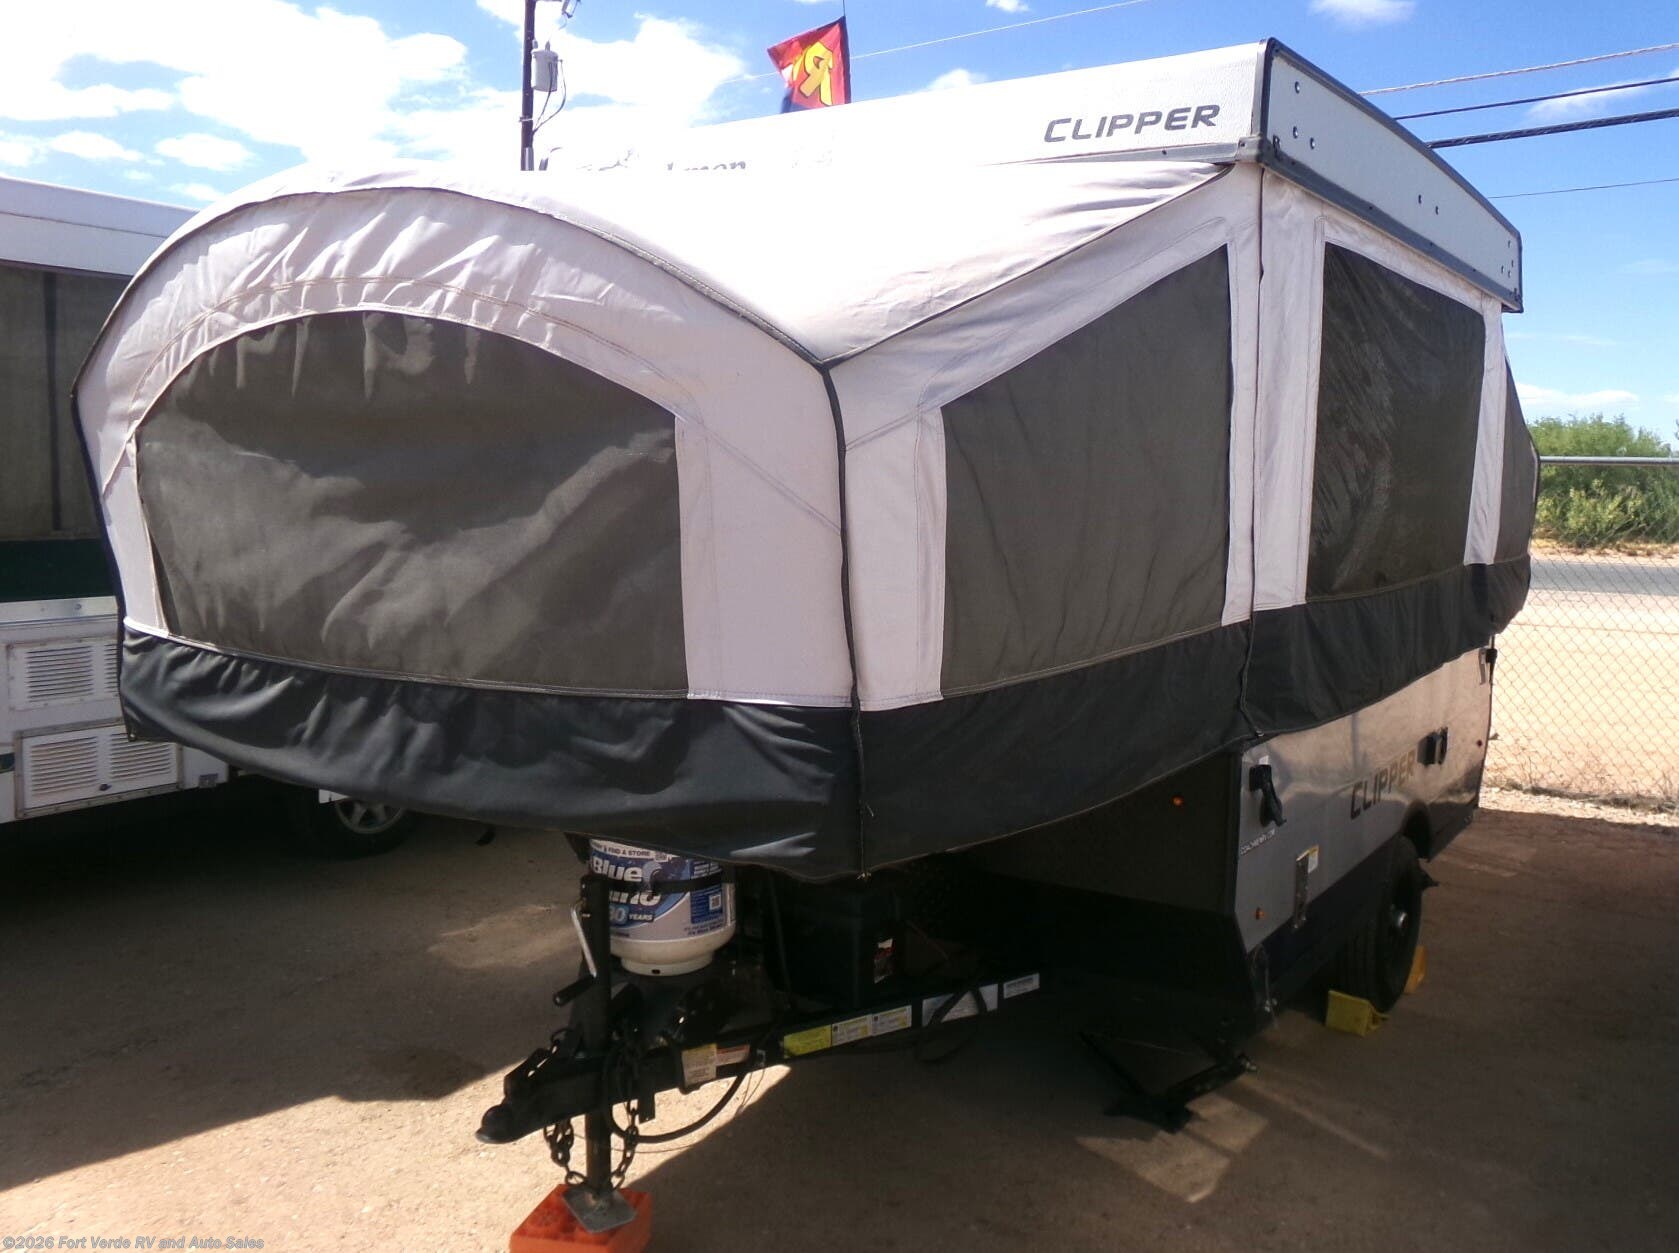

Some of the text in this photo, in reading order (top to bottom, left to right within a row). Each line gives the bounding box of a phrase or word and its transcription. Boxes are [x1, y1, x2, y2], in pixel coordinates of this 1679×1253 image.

[1043, 104, 1221, 143] CLIPPER
[1350, 749, 1416, 820] CLIPPER
[591, 856, 643, 882] Blue
[628, 911, 653, 921] YEARS
